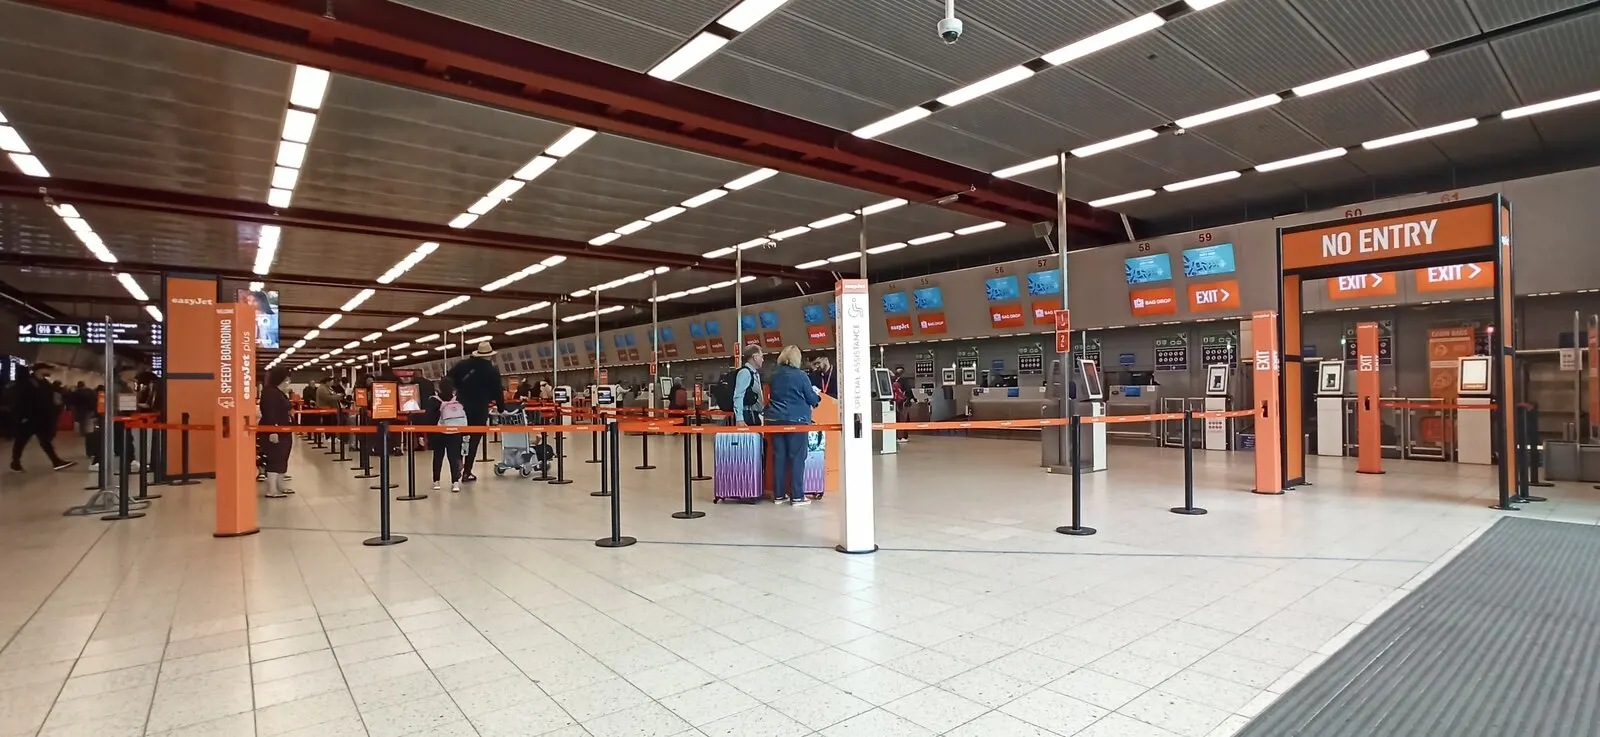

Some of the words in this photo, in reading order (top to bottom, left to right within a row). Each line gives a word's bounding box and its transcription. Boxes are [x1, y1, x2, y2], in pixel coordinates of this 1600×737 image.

[1198, 232, 1213, 243] 59
[1322, 231, 1351, 258] NO
[1359, 219, 1438, 254] ENTRY
[1138, 242, 1151, 252] 58
[994, 266, 1005, 274] 56
[1037, 259, 1048, 267] 57
[1338, 273, 1367, 291] EXIT
[1428, 264, 1464, 283] EXIT
[171, 297, 213, 306] easyJet
[1157, 297, 1172, 305] DROP
[1196, 289, 1219, 304] EXIT
[220, 319, 232, 361] BOARDING
[241, 331, 251, 352] plus
[1060, 334, 1065, 343] 2
[852, 324, 861, 374] ASSISTANCE
[1255, 349, 1271, 371] EXIT
[1359, 354, 1373, 372] EXIT
[220, 362, 232, 394] SPEEDY
[241, 354, 251, 400] easyJet
[853, 375, 861, 410] SPECIAL
